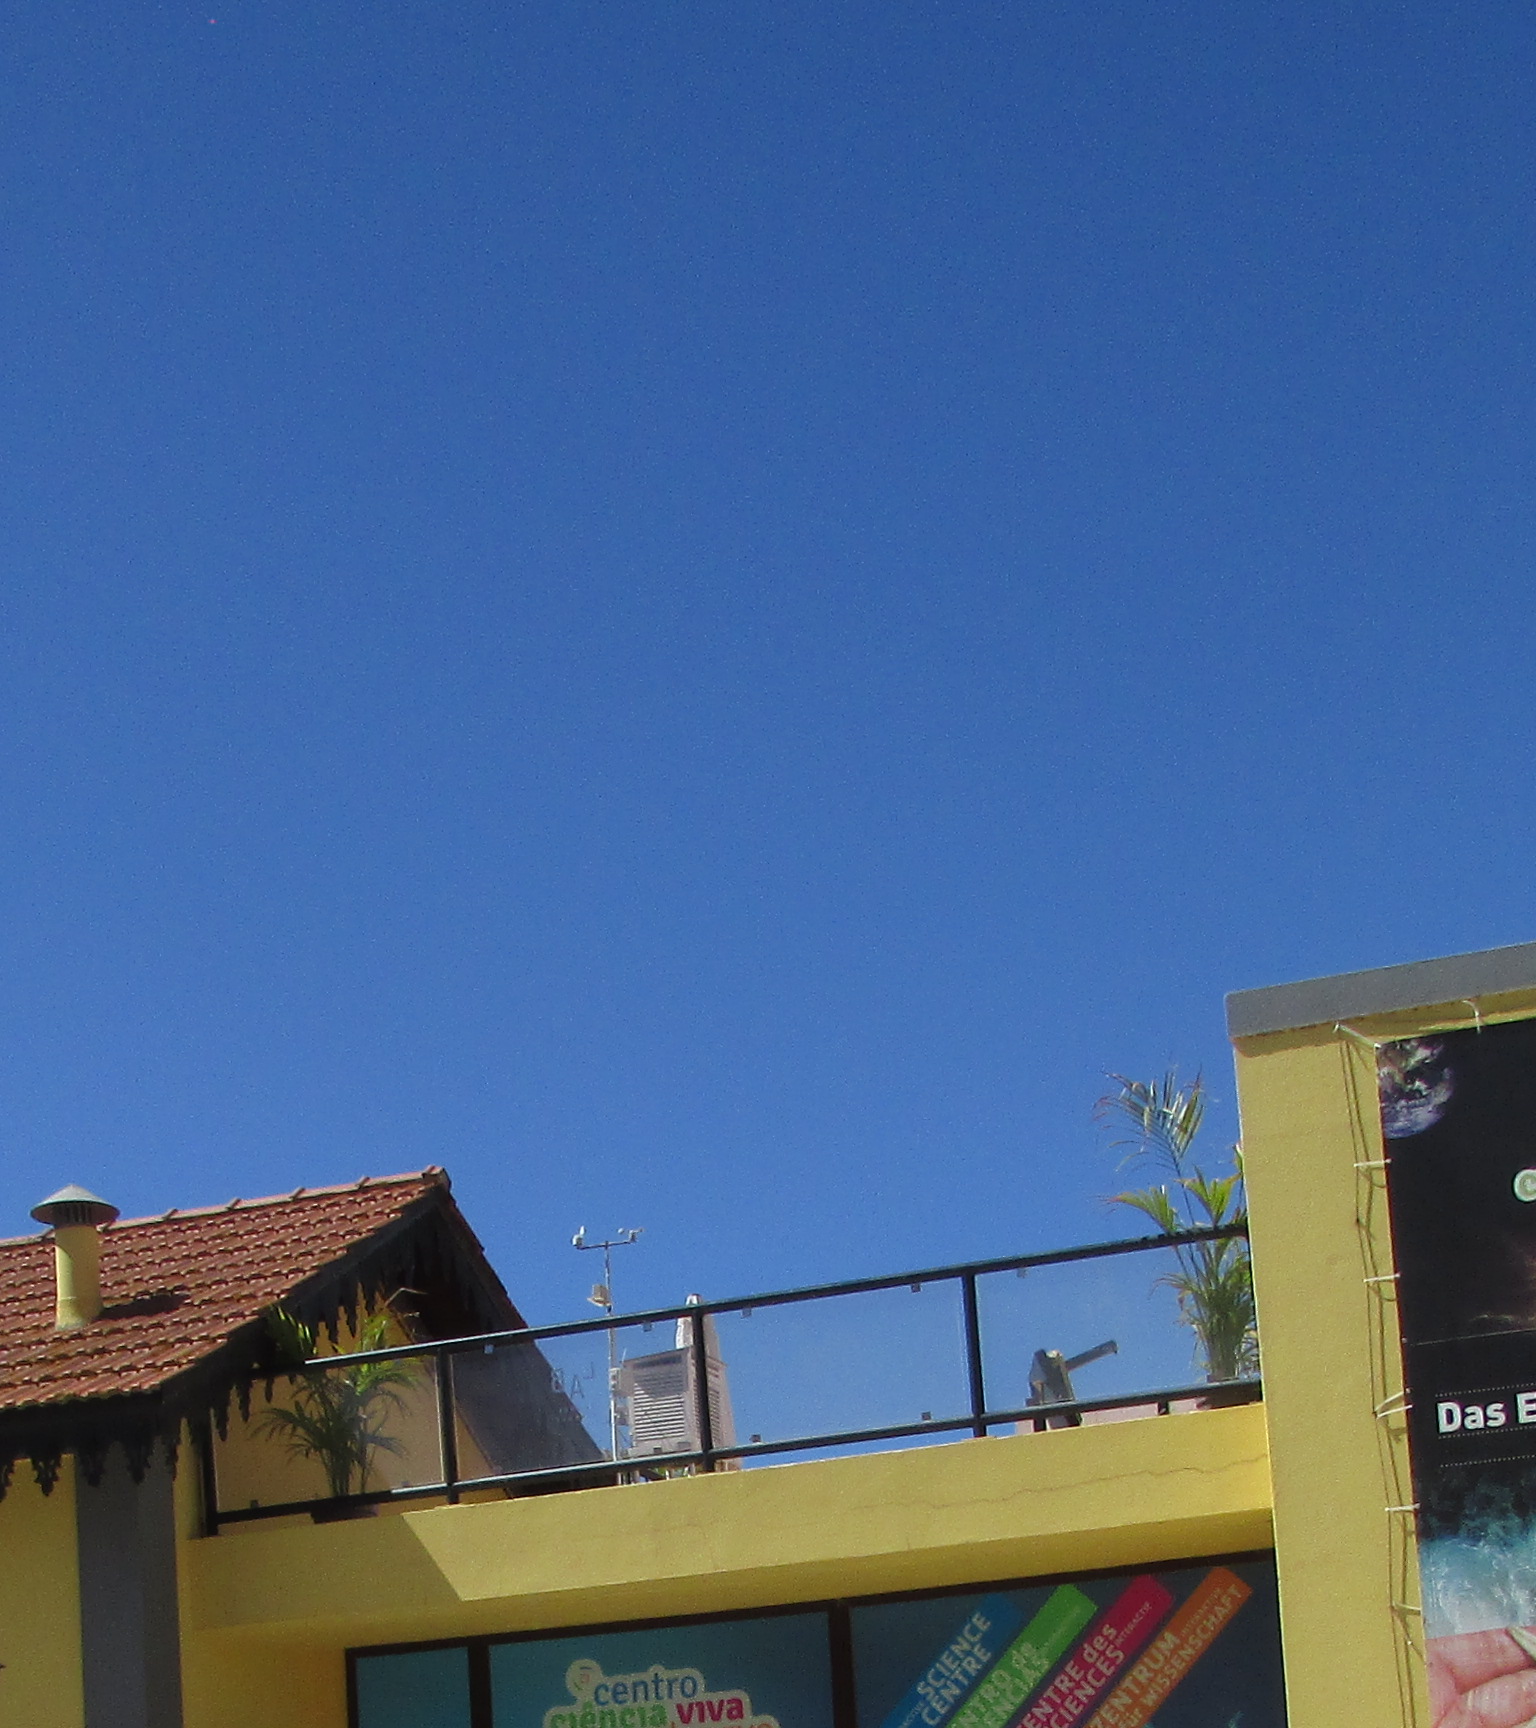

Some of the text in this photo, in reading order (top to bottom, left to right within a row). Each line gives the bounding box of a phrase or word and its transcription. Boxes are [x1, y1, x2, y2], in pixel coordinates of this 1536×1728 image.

[1436, 1400, 1507, 1434] Das
[916, 1611, 992, 1701] SCIENCE
[1082, 1623, 1118, 1663] des
[1142, 1583, 1243, 1708] WISSENSCHAFT
[594, 1672, 698, 1706] centro
[920, 1643, 992, 1726] CENTRE
[676, 1697, 744, 1724] viva
